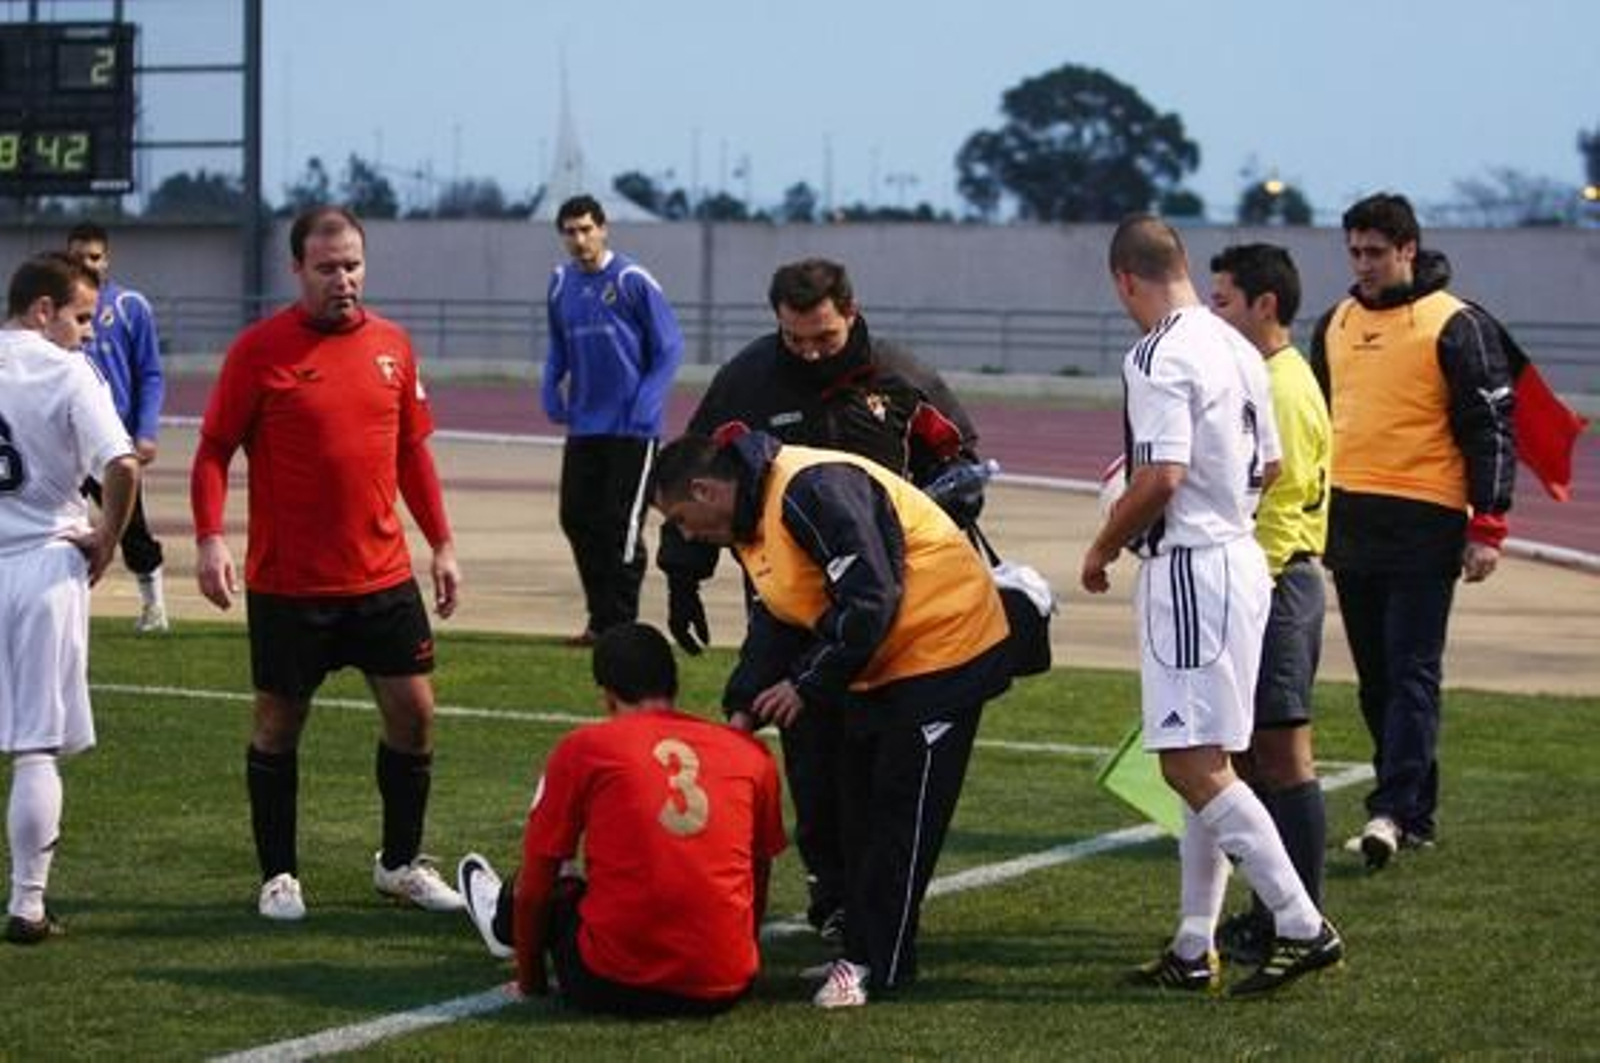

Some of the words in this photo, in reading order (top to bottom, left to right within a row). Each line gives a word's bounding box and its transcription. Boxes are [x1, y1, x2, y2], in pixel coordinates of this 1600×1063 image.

[90, 47, 116, 87] 2
[35, 134, 89, 171] 42
[653, 738, 709, 836] 3
